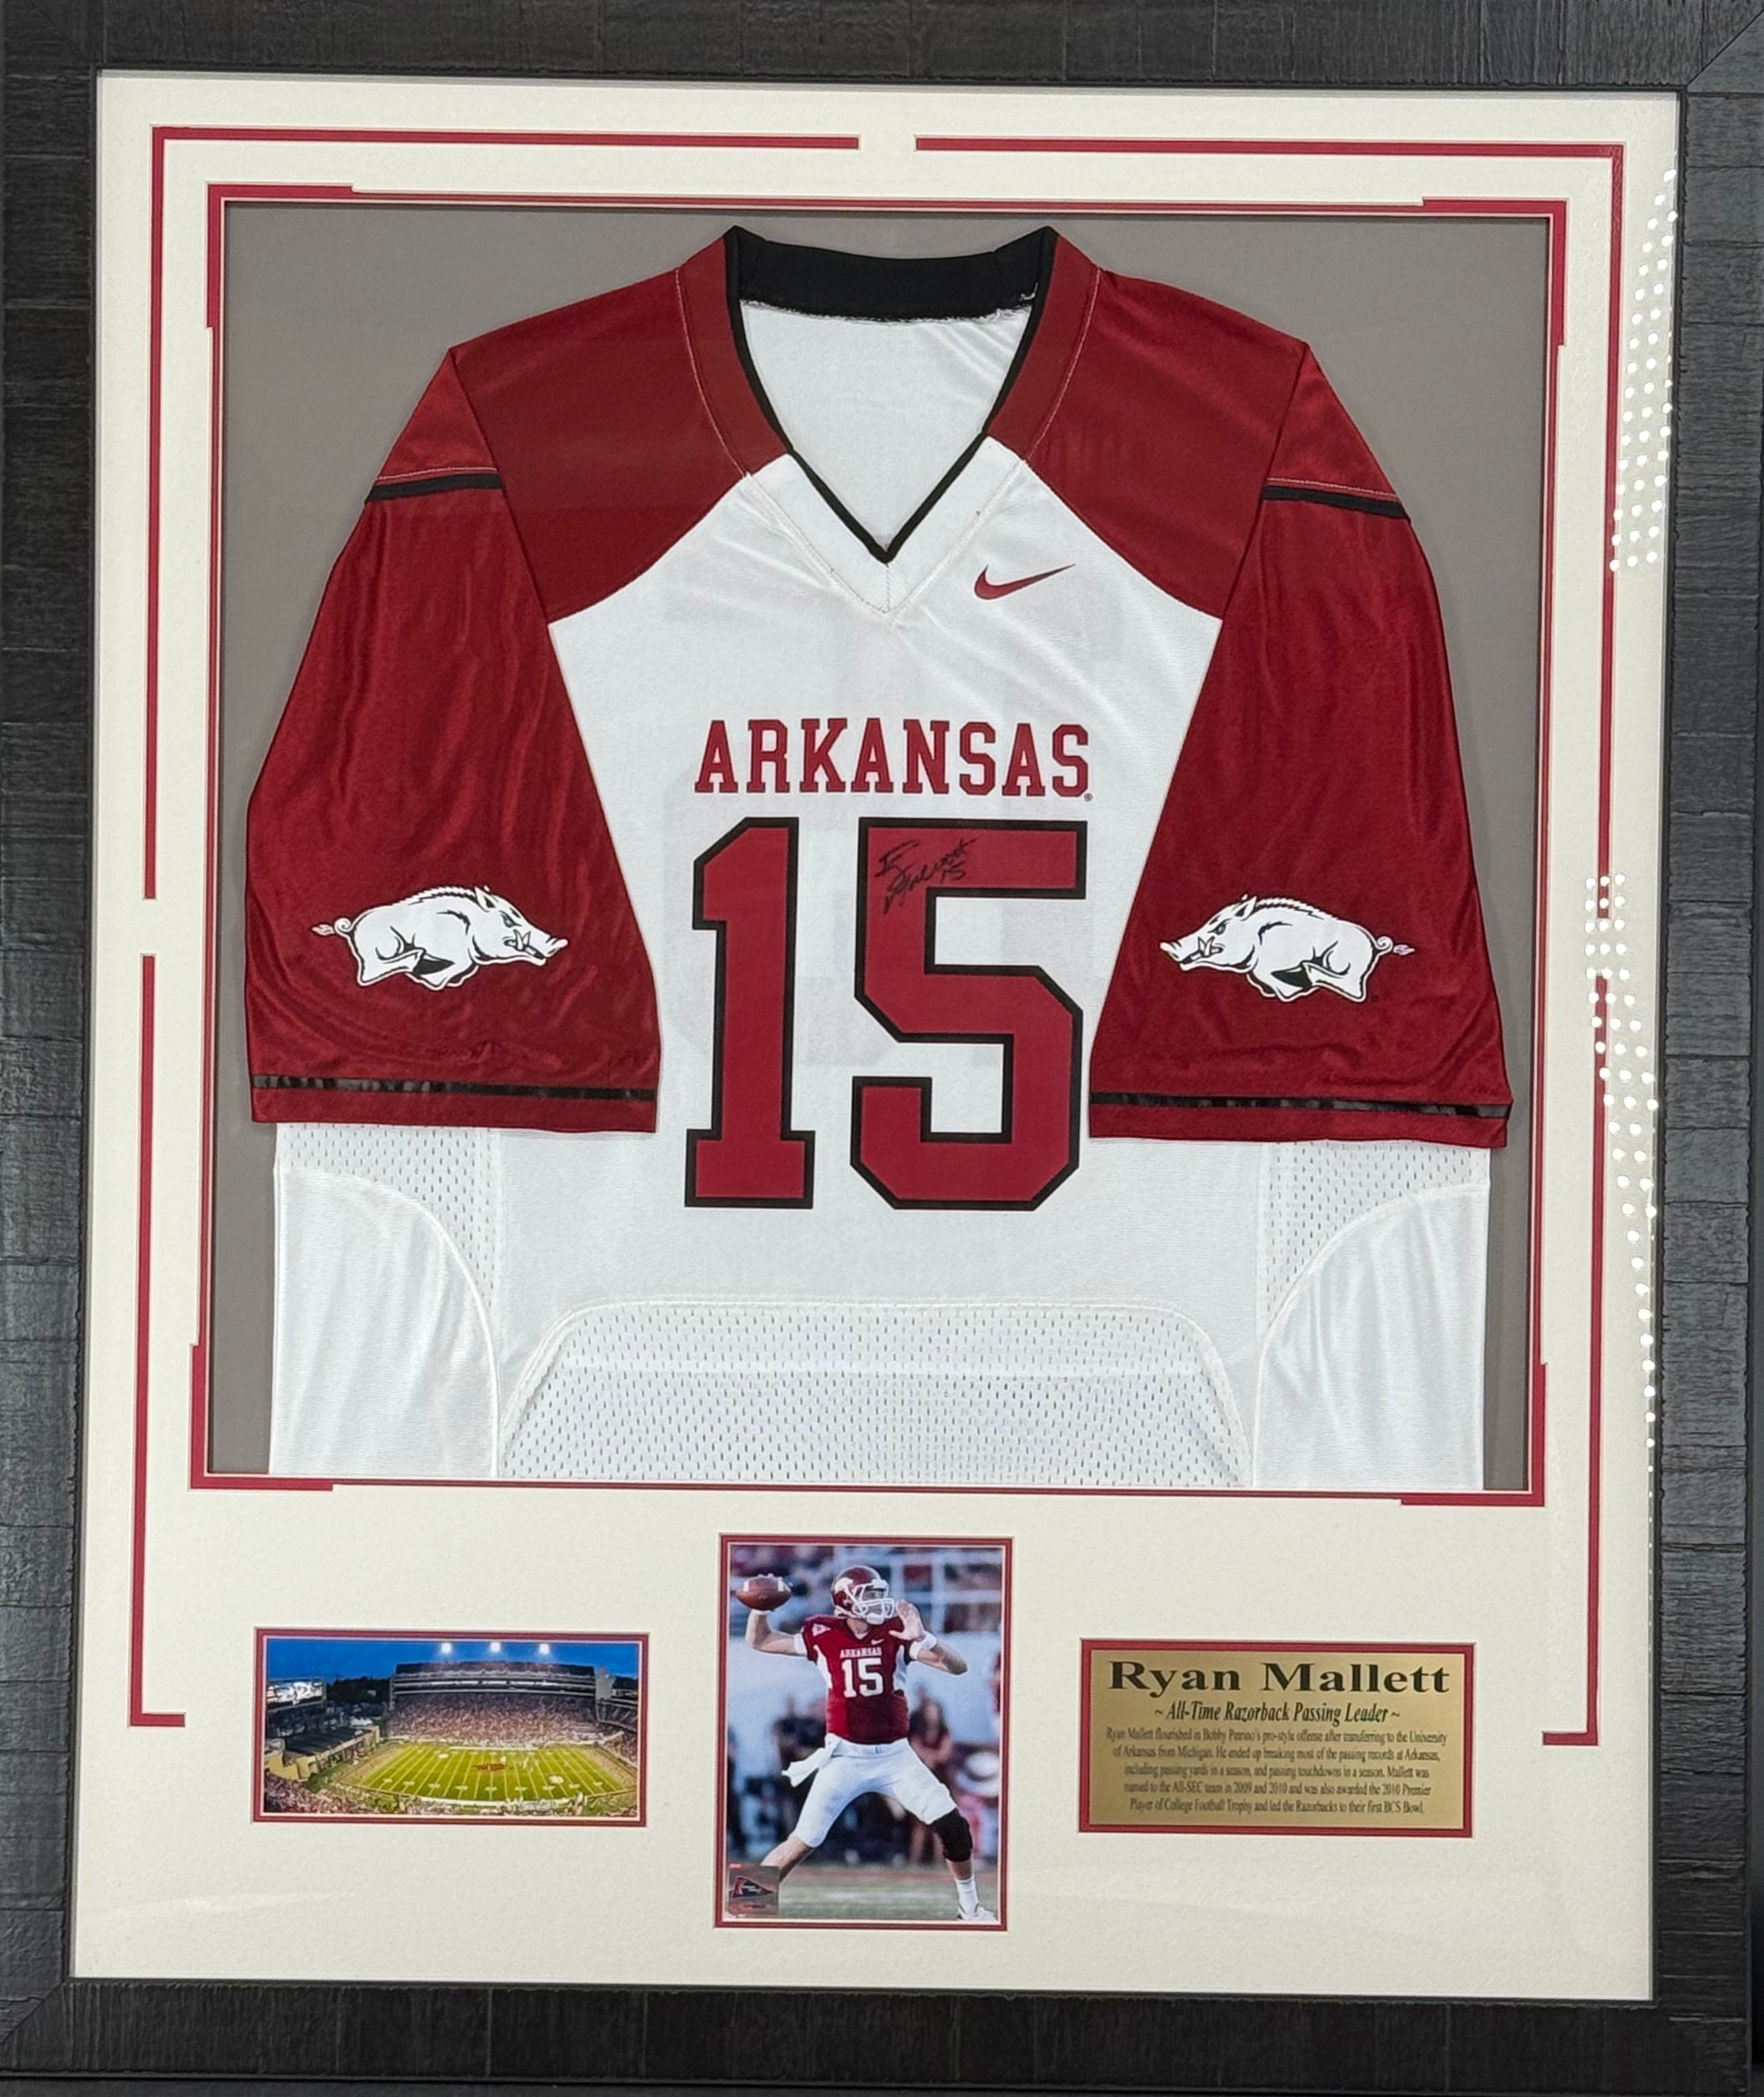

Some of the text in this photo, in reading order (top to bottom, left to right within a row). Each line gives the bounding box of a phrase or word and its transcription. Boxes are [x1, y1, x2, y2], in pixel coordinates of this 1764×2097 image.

[695, 718, 1089, 797] ARKANSAS
[685, 817, 1087, 1211] 15
[842, 1658, 883, 1697] 15
[1108, 1661, 1450, 1697] Ryan Mallett
[1166, 1701, 1221, 1720] All-Time
[1223, 1701, 1289, 1722] Razorback
[1293, 1702, 1341, 1727] Passing
[1344, 1703, 1388, 1723] Leader
